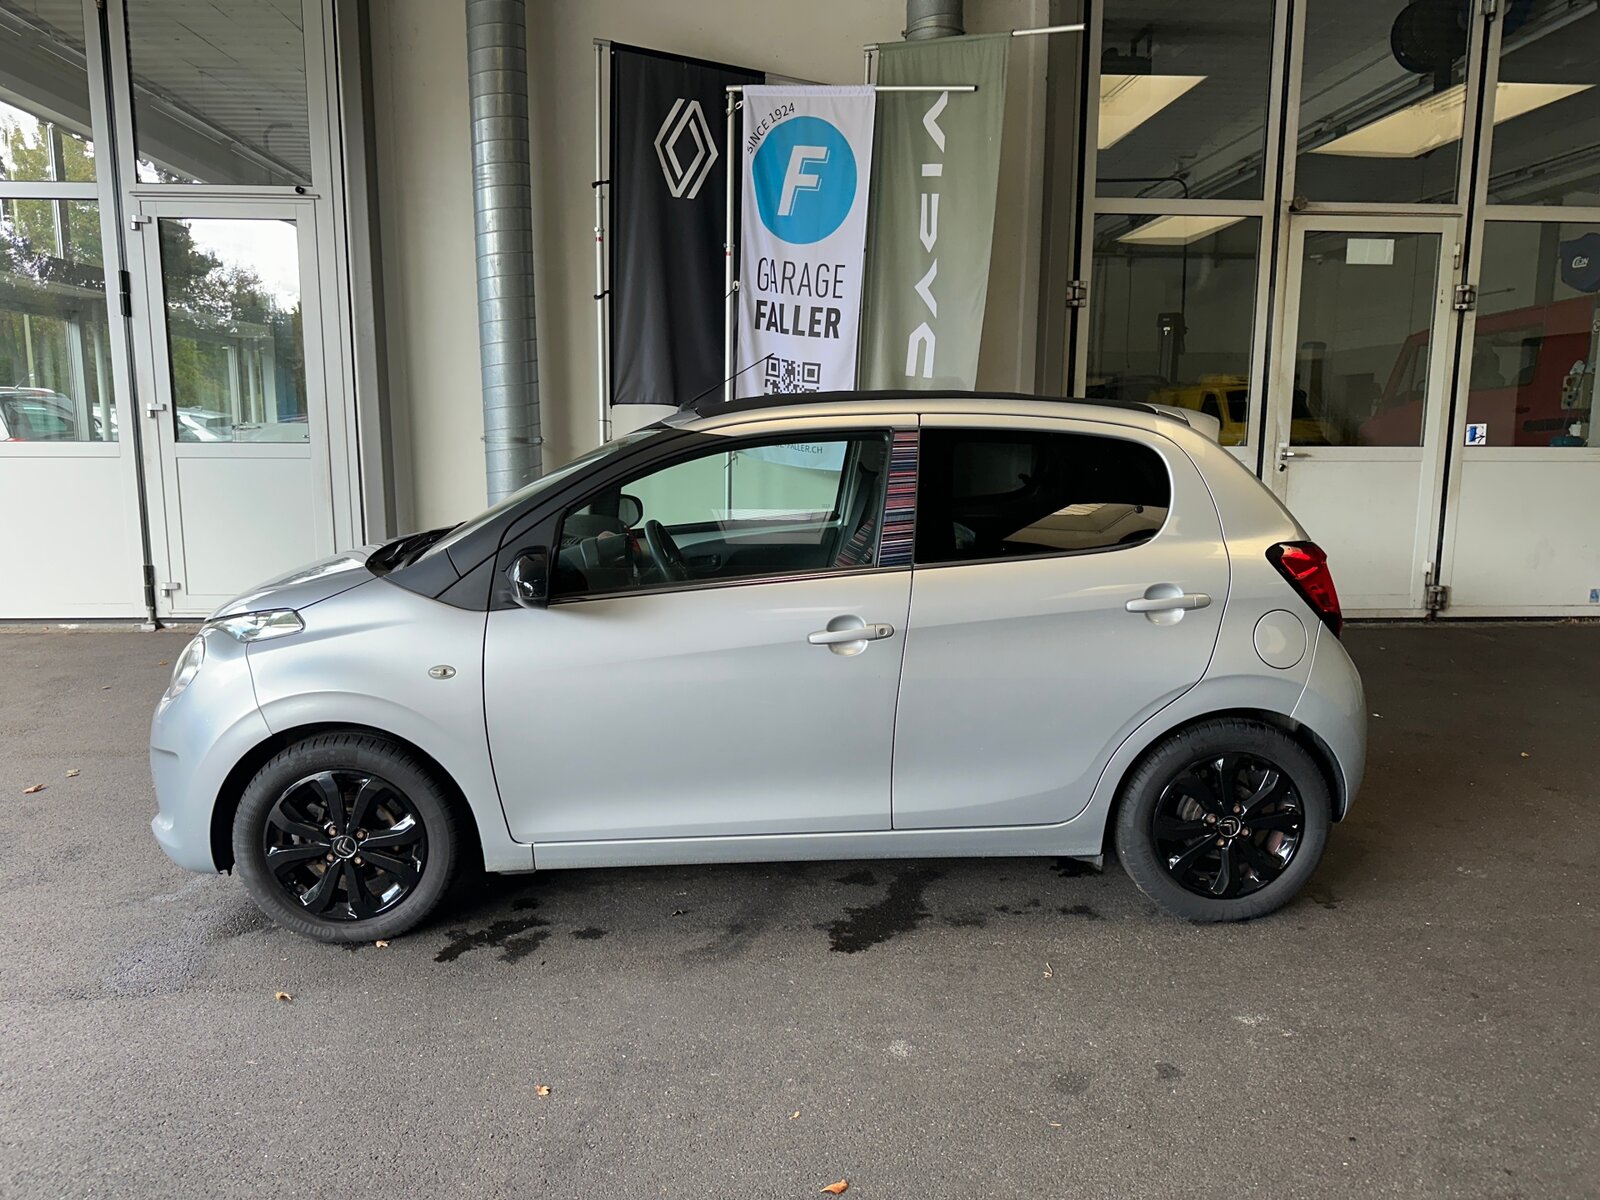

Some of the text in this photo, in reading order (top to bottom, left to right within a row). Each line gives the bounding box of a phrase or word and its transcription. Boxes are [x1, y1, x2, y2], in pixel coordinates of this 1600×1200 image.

[746, 102, 795, 154] SINCE 1924
[777, 144, 831, 217] F
[757, 257, 846, 299] GARAGE
[754, 299, 841, 339] FALLER
